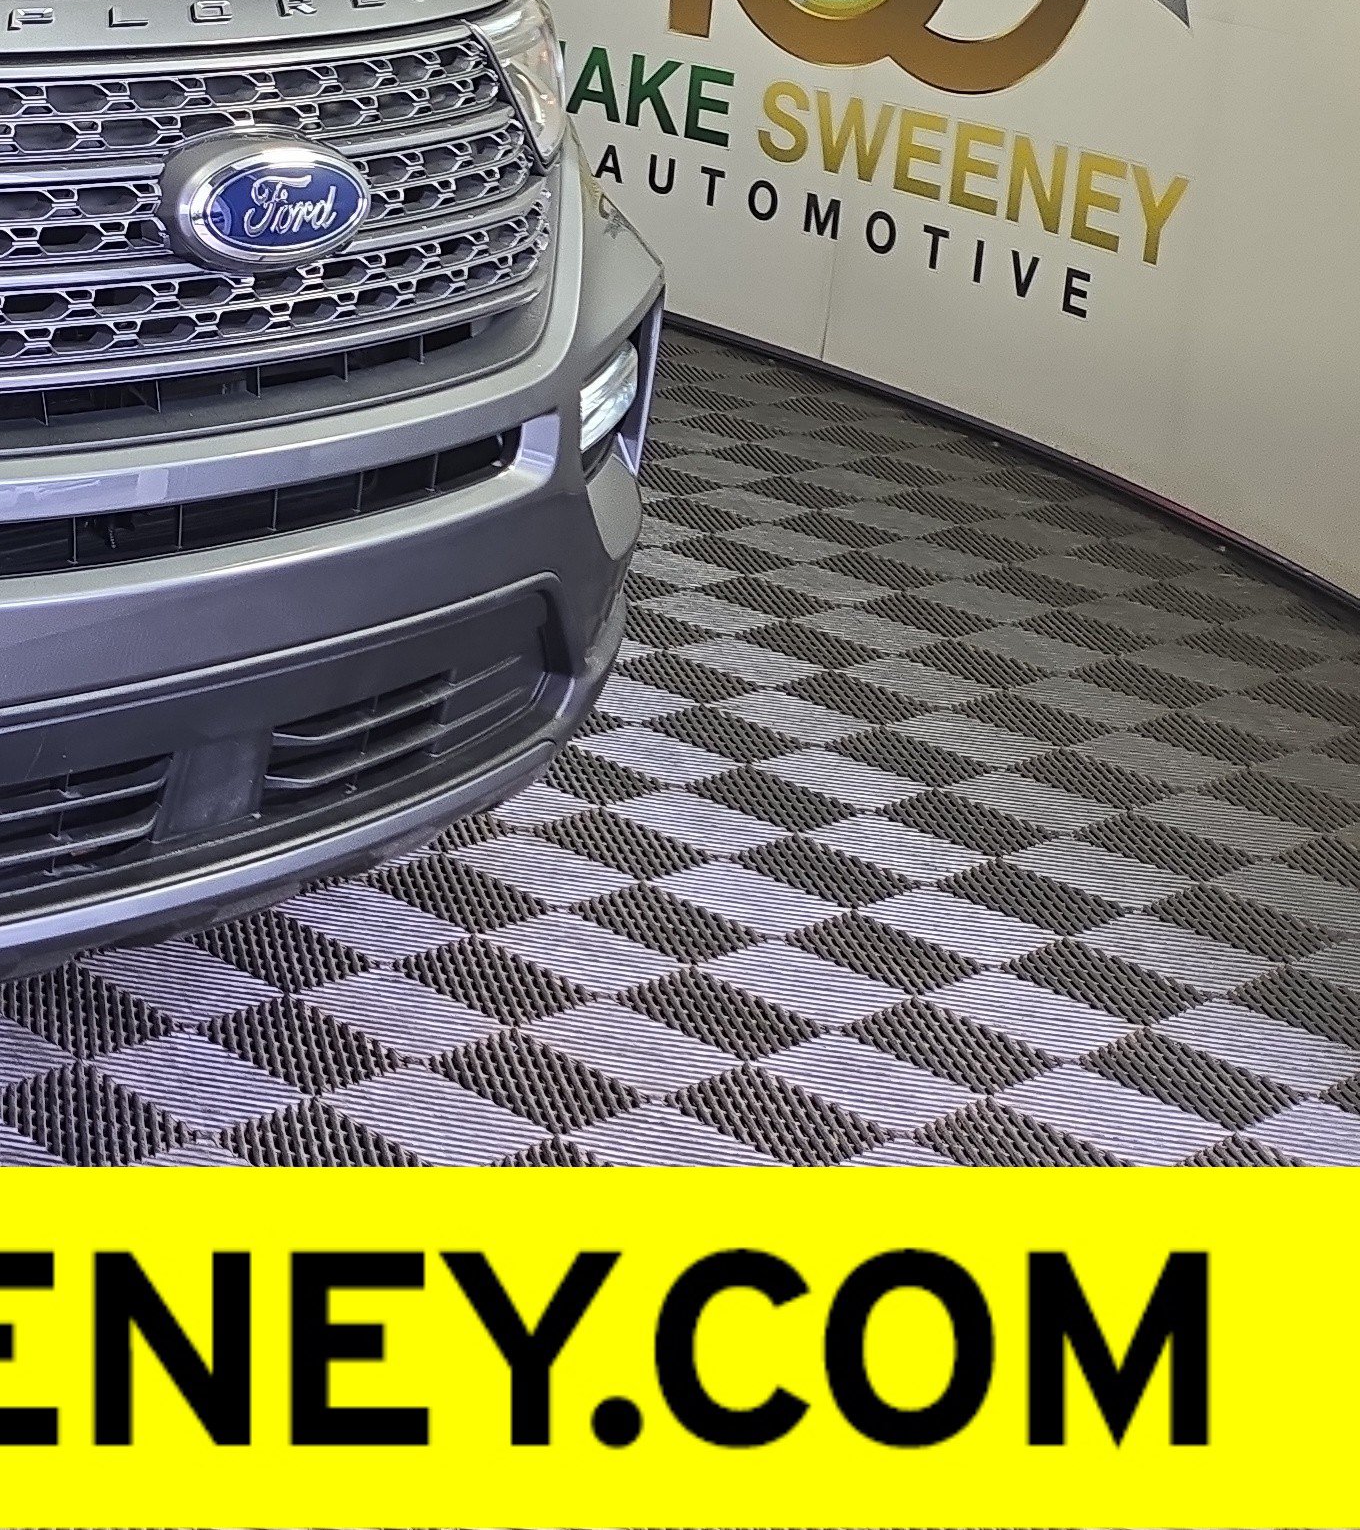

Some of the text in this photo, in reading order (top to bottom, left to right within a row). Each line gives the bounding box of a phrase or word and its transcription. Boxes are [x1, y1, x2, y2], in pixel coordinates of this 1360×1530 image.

[243, 174, 337, 238] Ford
[559, 40, 1189, 266] AKE SWEENEY
[594, 144, 1091, 318] AUTOMOTIVE
